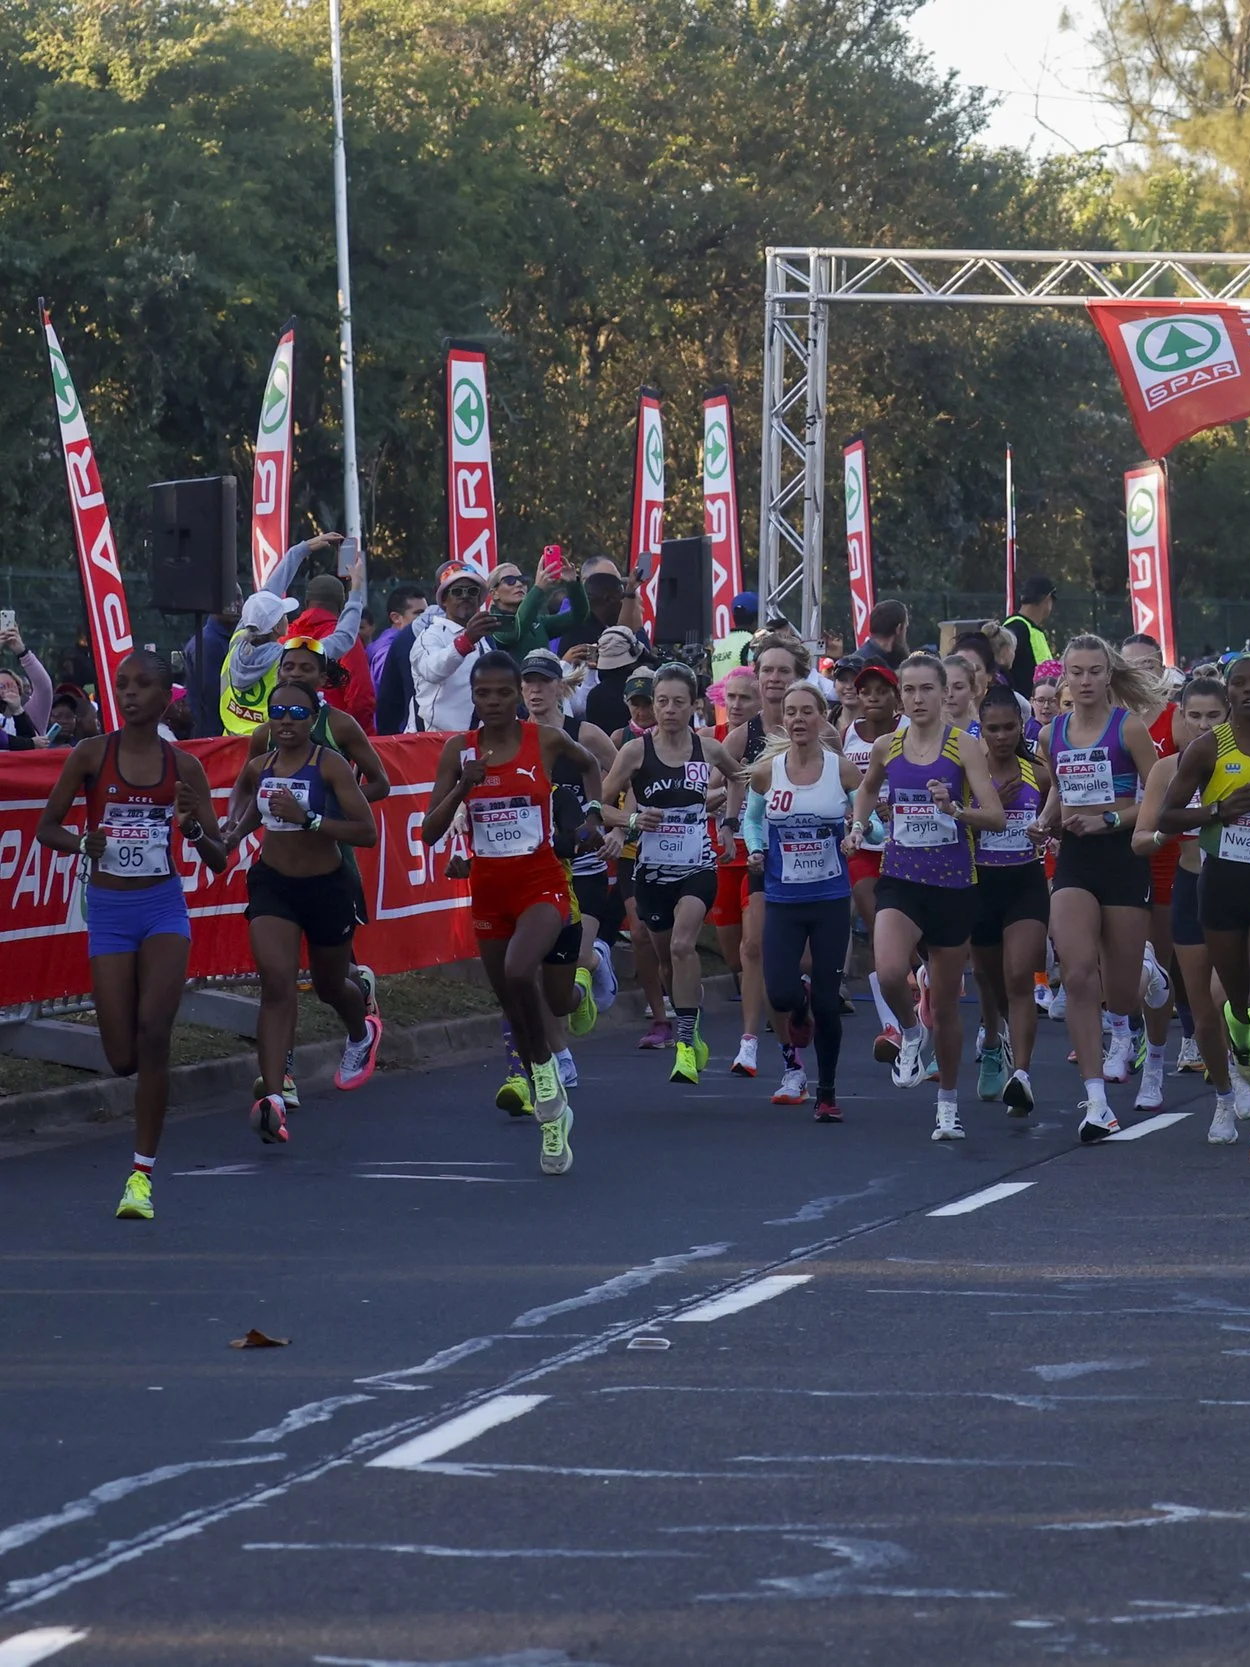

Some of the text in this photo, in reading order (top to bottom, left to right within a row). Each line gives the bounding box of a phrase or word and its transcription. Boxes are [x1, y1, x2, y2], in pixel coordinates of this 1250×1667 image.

[1149, 363, 1234, 403] SPAR
[67, 446, 134, 653] PAR
[227, 700, 264, 722] SPAR
[687, 763, 708, 782] 60
[1065, 765, 1095, 773] SPAR
[1063, 779, 1109, 791] Danielle
[770, 790, 793, 812] 50
[482, 811, 518, 822] SPAR
[112, 829, 149, 837] SPAR
[486, 828, 522, 842] Lebo
[904, 822, 938, 835] Tayla
[659, 840, 683, 852] Gail
[791, 843, 821, 851] SPAR
[119, 846, 143, 867] 95
[793, 858, 825, 870] Anne
